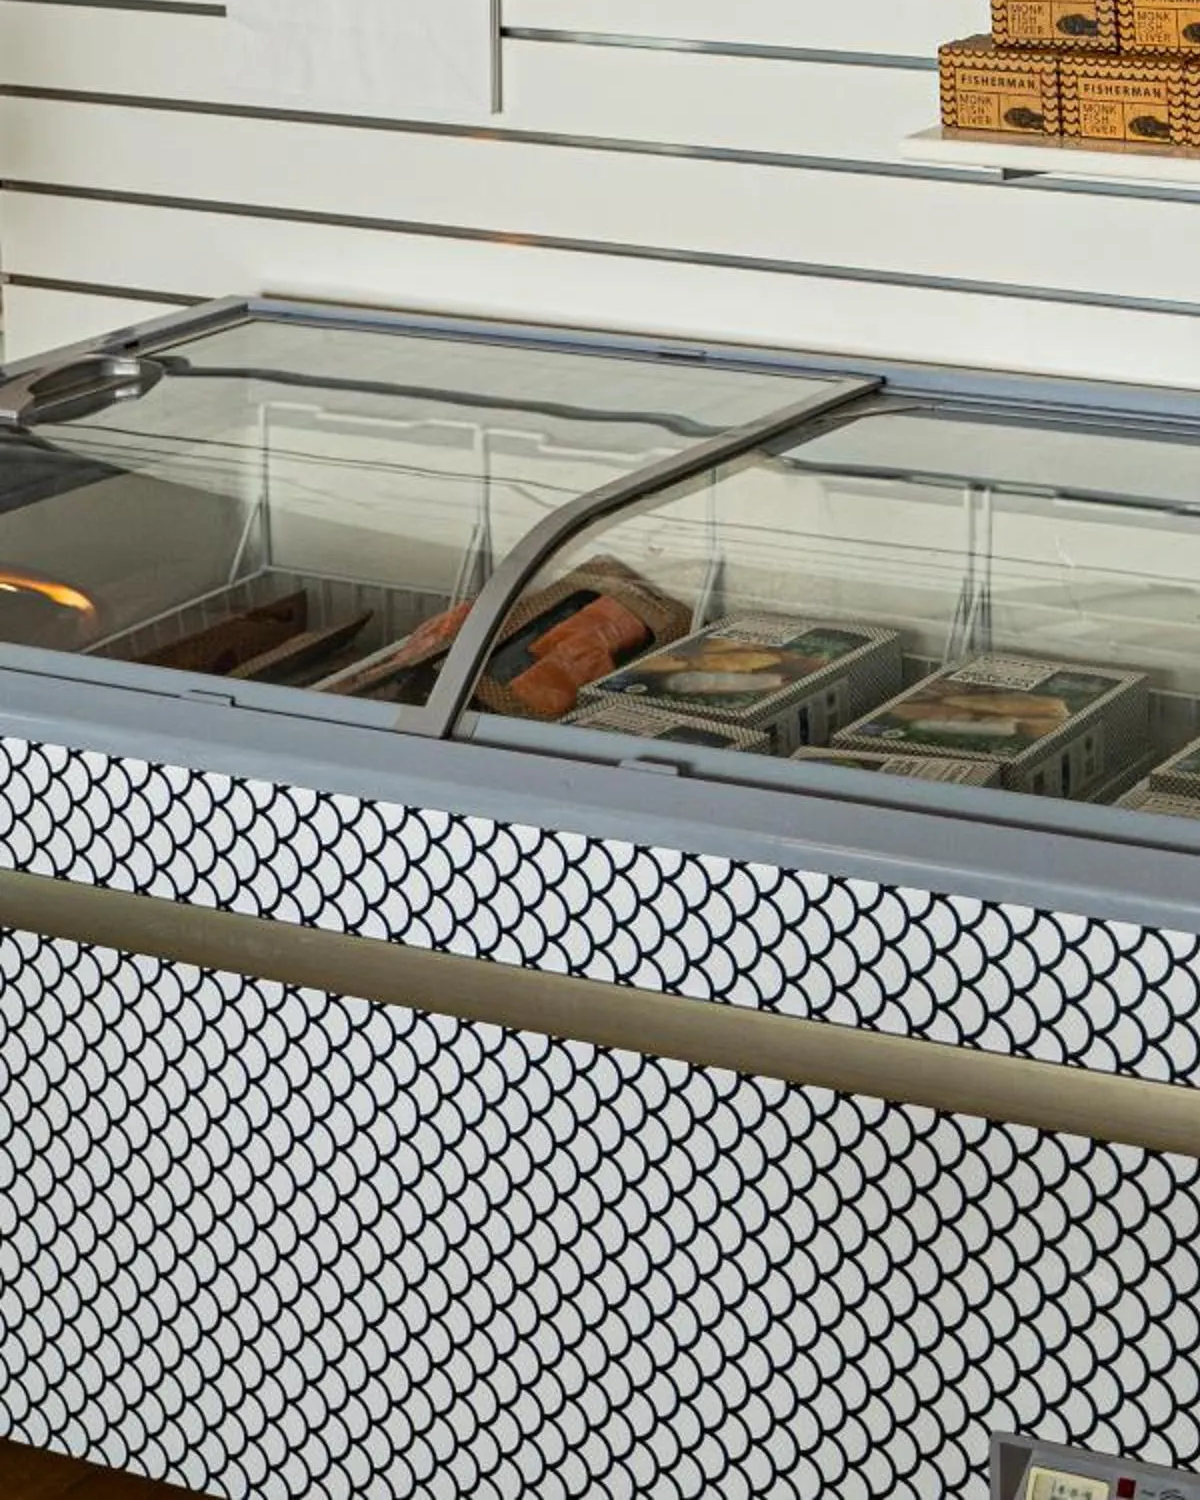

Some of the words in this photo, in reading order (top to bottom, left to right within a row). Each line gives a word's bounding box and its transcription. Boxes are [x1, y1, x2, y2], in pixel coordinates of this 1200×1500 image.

[1011, 3, 1044, 15] MONK
[1137, 10, 1170, 22] MONK
[960, 74, 1036, 89] FISHERMAN
[1083, 83, 1161, 98] FISHERMAN
[959, 93, 993, 105] MONK
[1083, 103, 1116, 115] MONK
